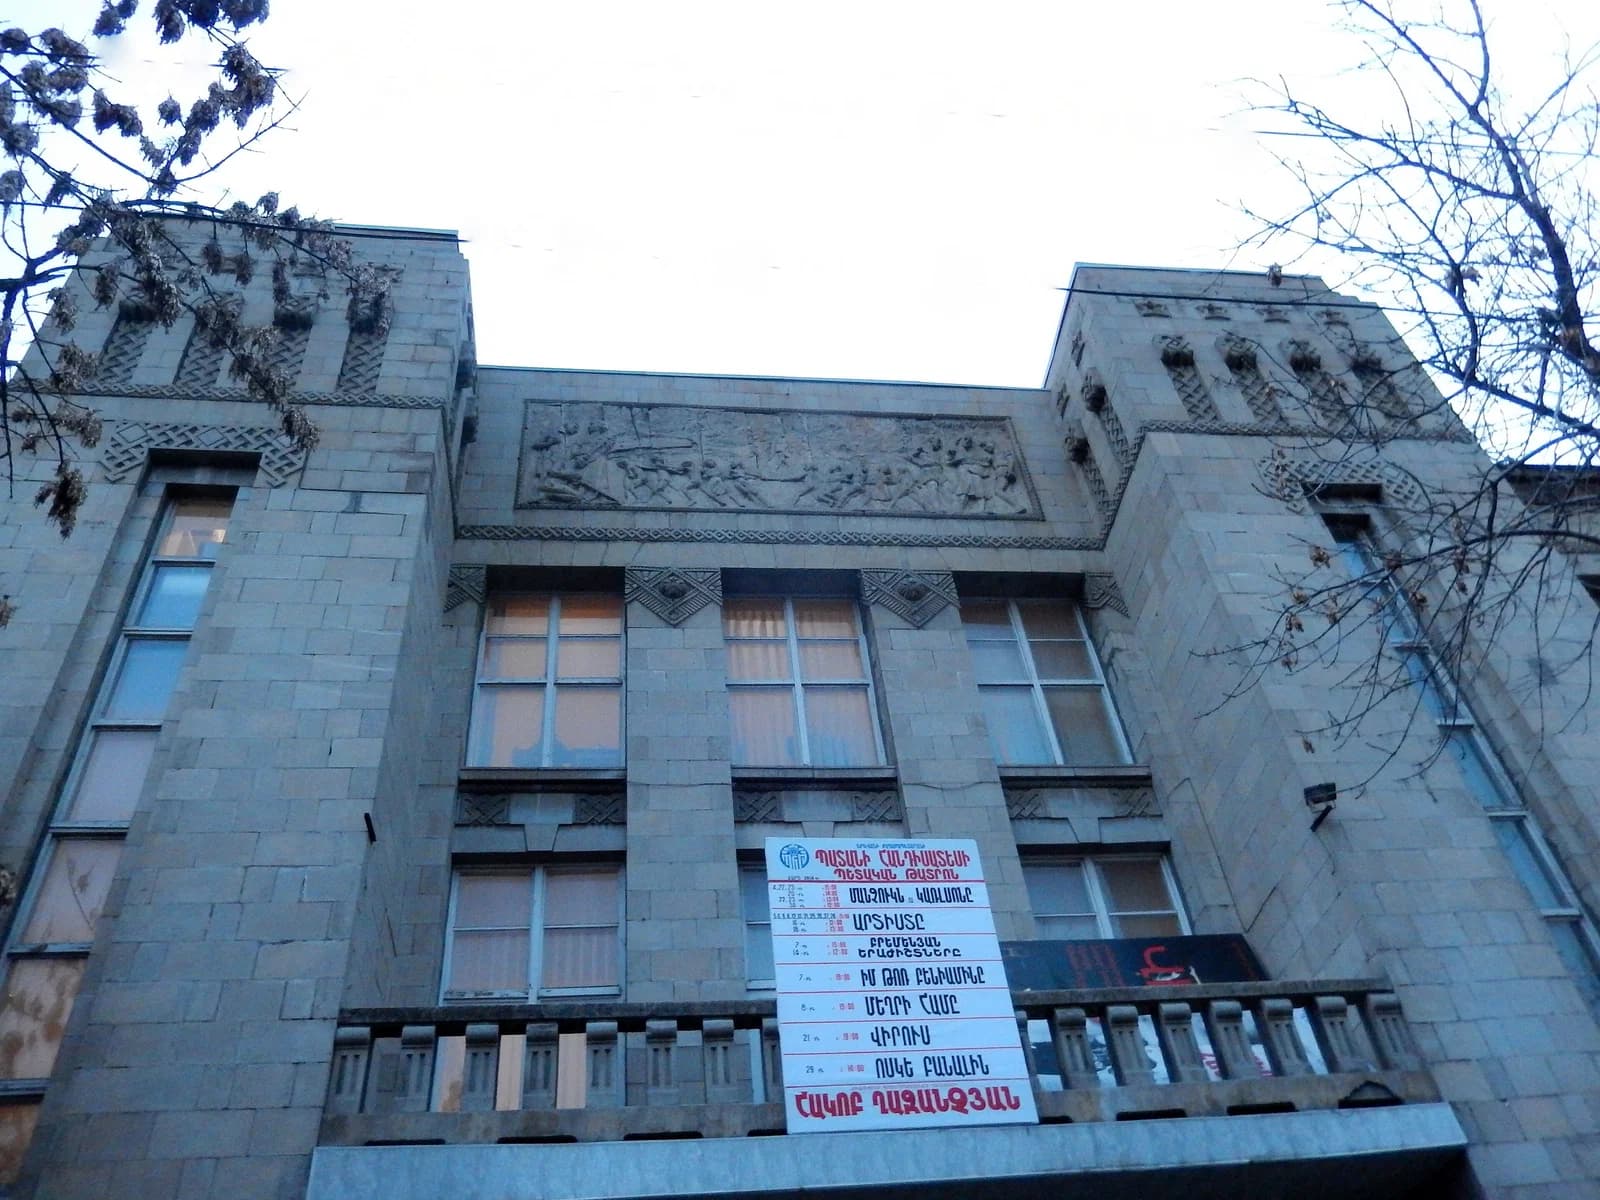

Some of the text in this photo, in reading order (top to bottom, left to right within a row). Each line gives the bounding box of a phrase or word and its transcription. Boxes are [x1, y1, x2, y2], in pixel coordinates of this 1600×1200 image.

[815, 849, 970, 868] ՊԱՏԱՆԻ ՀԱՆԴԻՍԱՏԵՍԻ
[834, 868, 897, 880] ՊԵՏԱԿԱՆ
[905, 868, 959, 880] ԹԱՏՐՈՆ
[915, 887, 974, 904] ԿԱՌԼՍՈՆԸ
[853, 913, 925, 931] ԱՐՏԻՍՏԸ
[870, 936, 941, 948] ԲՐԵՄԵՆՅԱՆ
[858, 948, 961, 958] ԵՐԱԺԻՇՏՆԵՐԸ
[861, 966, 985, 987] ԻՄ ԹՈՌ ԲԵՆԻԱՄԻՆԸ
[865, 993, 960, 1016] ՄԵՂՐԻ ՀԱՄԸ
[871, 1025, 931, 1047] ՎԻՐՈՒՍ
[875, 1054, 990, 1078] ՈՍԿԵ ԲԱՆԱԼԻՆ
[795, 1091, 864, 1119] ՀԱԿՈԲ
